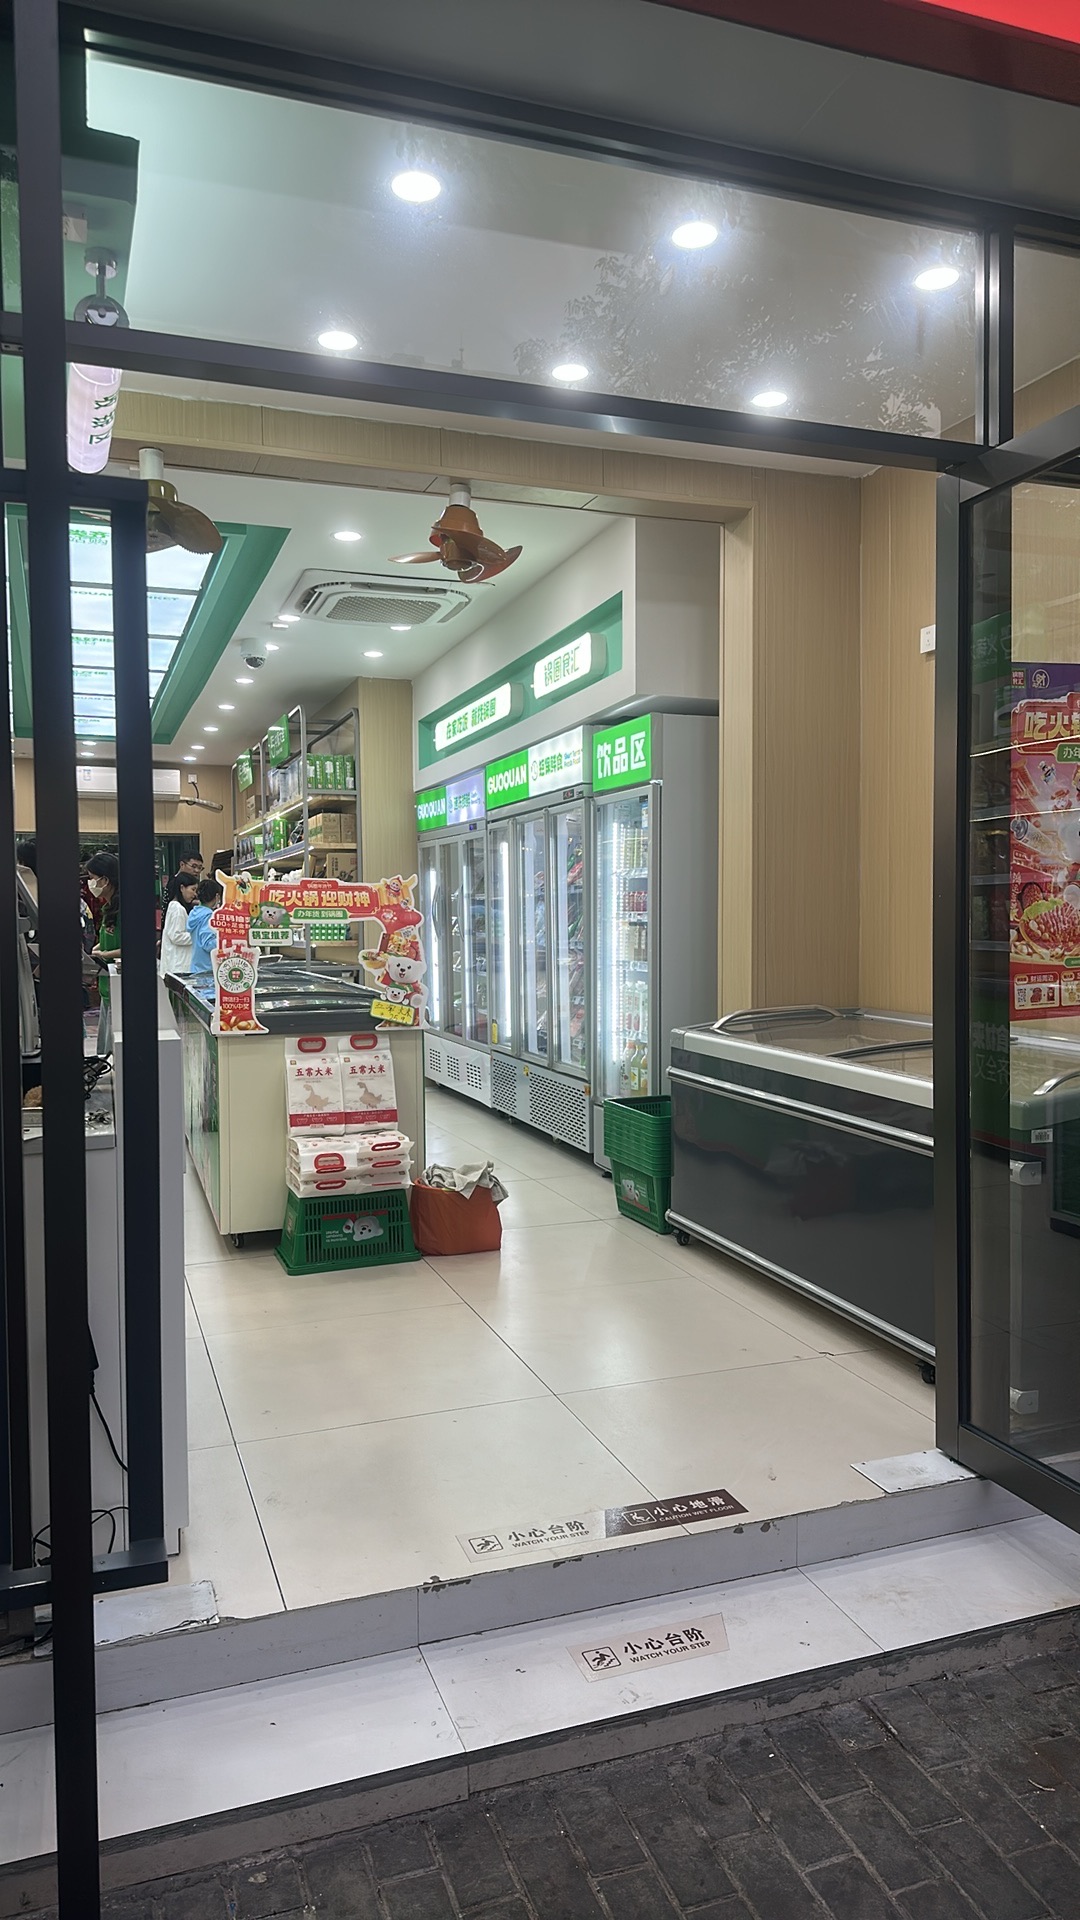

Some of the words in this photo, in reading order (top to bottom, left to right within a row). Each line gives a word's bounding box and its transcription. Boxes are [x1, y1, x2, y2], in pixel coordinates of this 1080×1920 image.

[544, 643, 581, 687] 锅圈食汇
[446, 715, 468, 740] 在家吃饭
[471, 697, 496, 728] 就找锅圈
[596, 731, 647, 779] 饮品区
[487, 764, 527, 795] GUOQUAN
[417, 798, 446, 820] GUOQUAN
[269, 889, 319, 907] 吃火锅
[321, 891, 370, 907] 迎财神
[297, 910, 320, 918] 办年货
[252, 930, 289, 940] 锅宝推荐
[295, 1066, 333, 1077] 五常大米
[349, 1064, 386, 1075] 五常大米
[654, 1496, 725, 1516] 小心地滑
[659, 1512, 692, 1522] CAUTION
[709, 1505, 734, 1513] FLOOR
[508, 1520, 586, 1541] 小心台阶
[512, 1539, 543, 1548] WATCH
[545, 1534, 569, 1543] YOUR
[570, 1530, 590, 1539] STEP
[624, 1627, 706, 1655] 小心台阶
[629, 1651, 662, 1663] WATCH
[663, 1645, 690, 1656] YOUR
[690, 1640, 711, 1650] STEP
